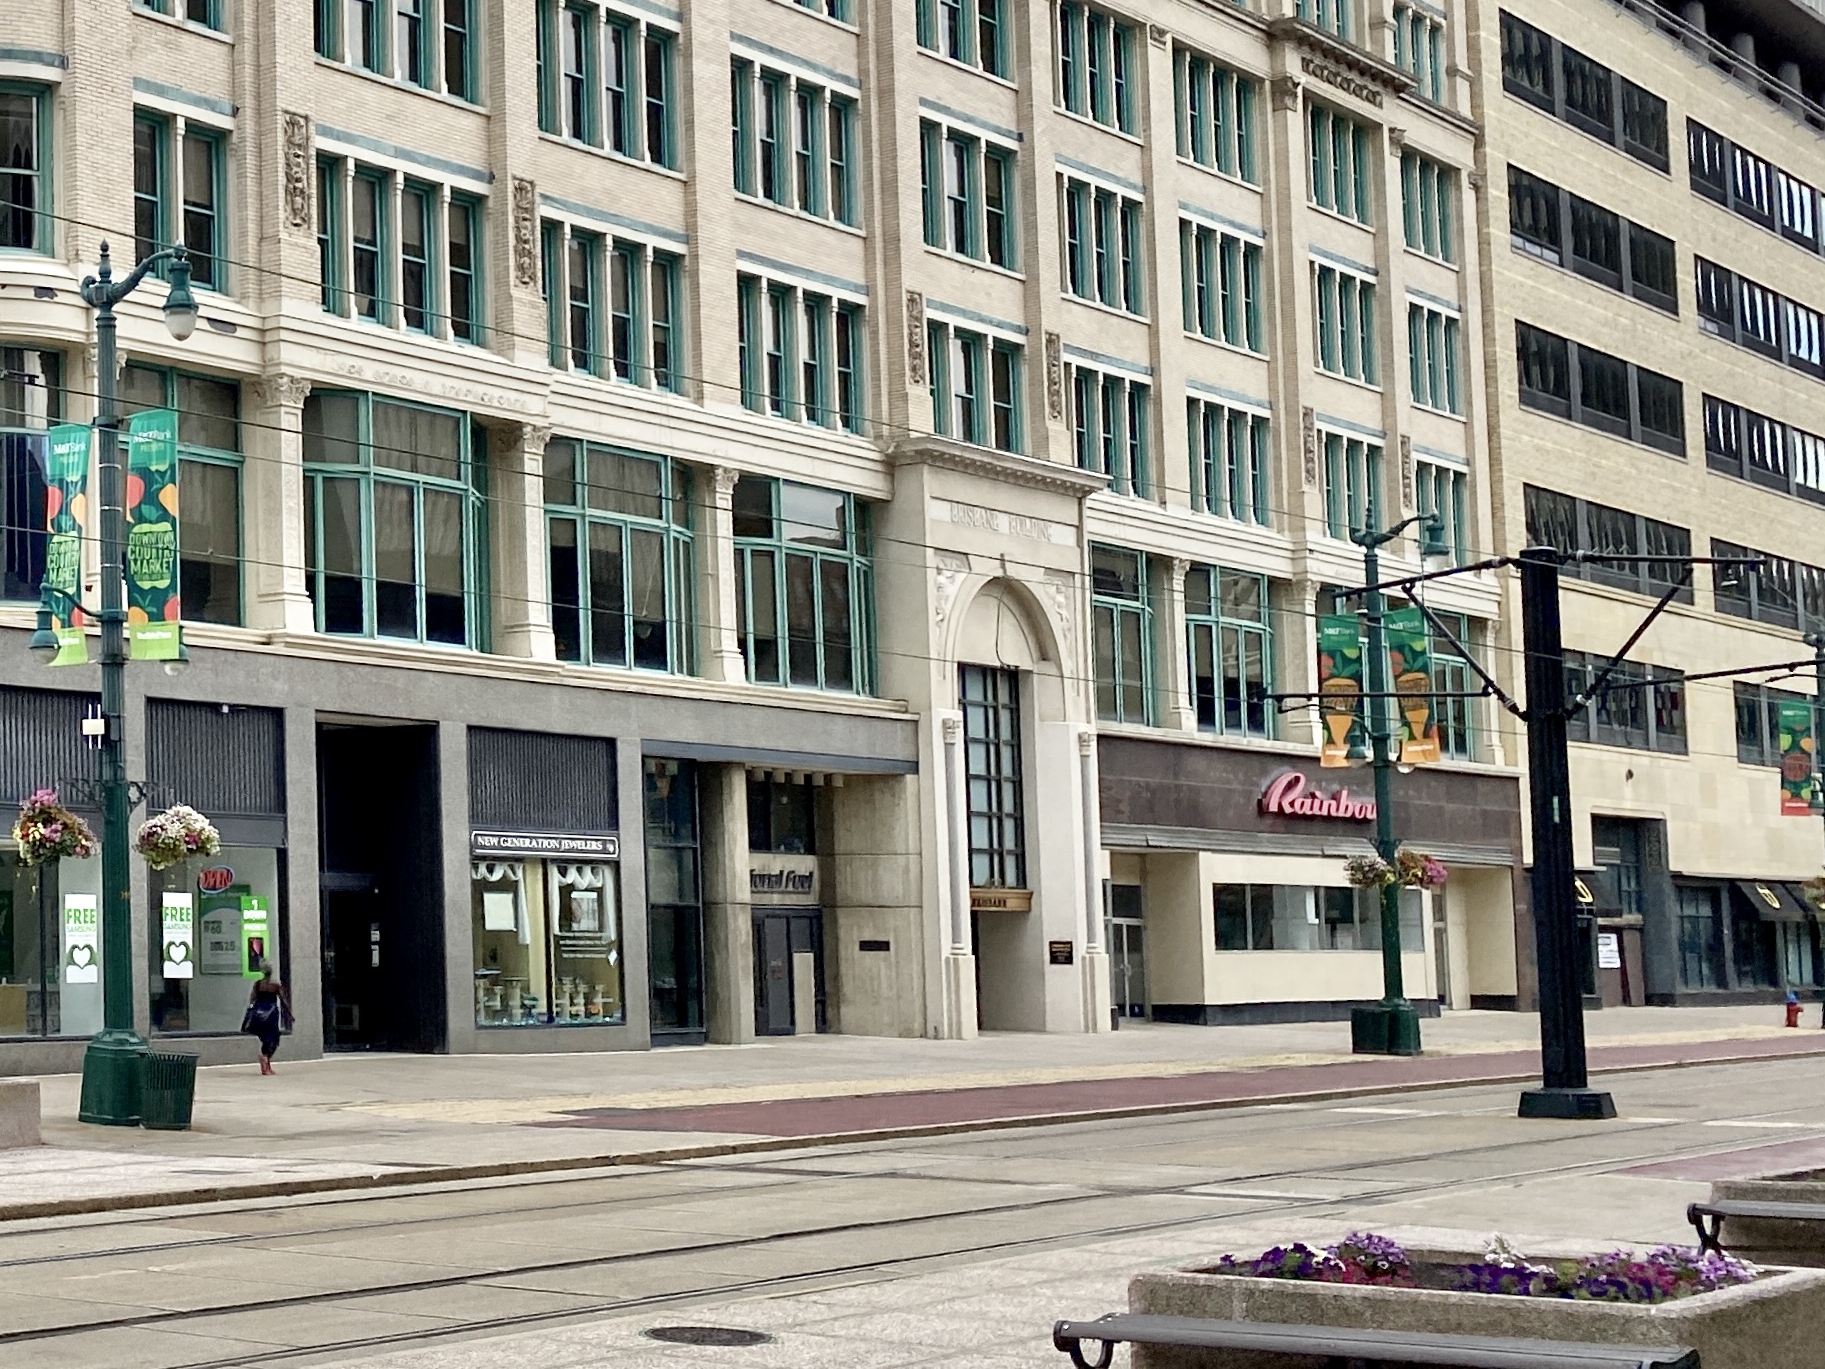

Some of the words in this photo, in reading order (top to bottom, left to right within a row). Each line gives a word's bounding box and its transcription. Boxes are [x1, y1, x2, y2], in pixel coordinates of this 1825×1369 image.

[130, 557, 173, 575] MARKET
[477, 836, 500, 847] NEW
[500, 837, 560, 849] GENERATION
[560, 841, 603, 851] JEWELERS
[66, 909, 96, 924] FREE
[163, 907, 191, 922] FREE
